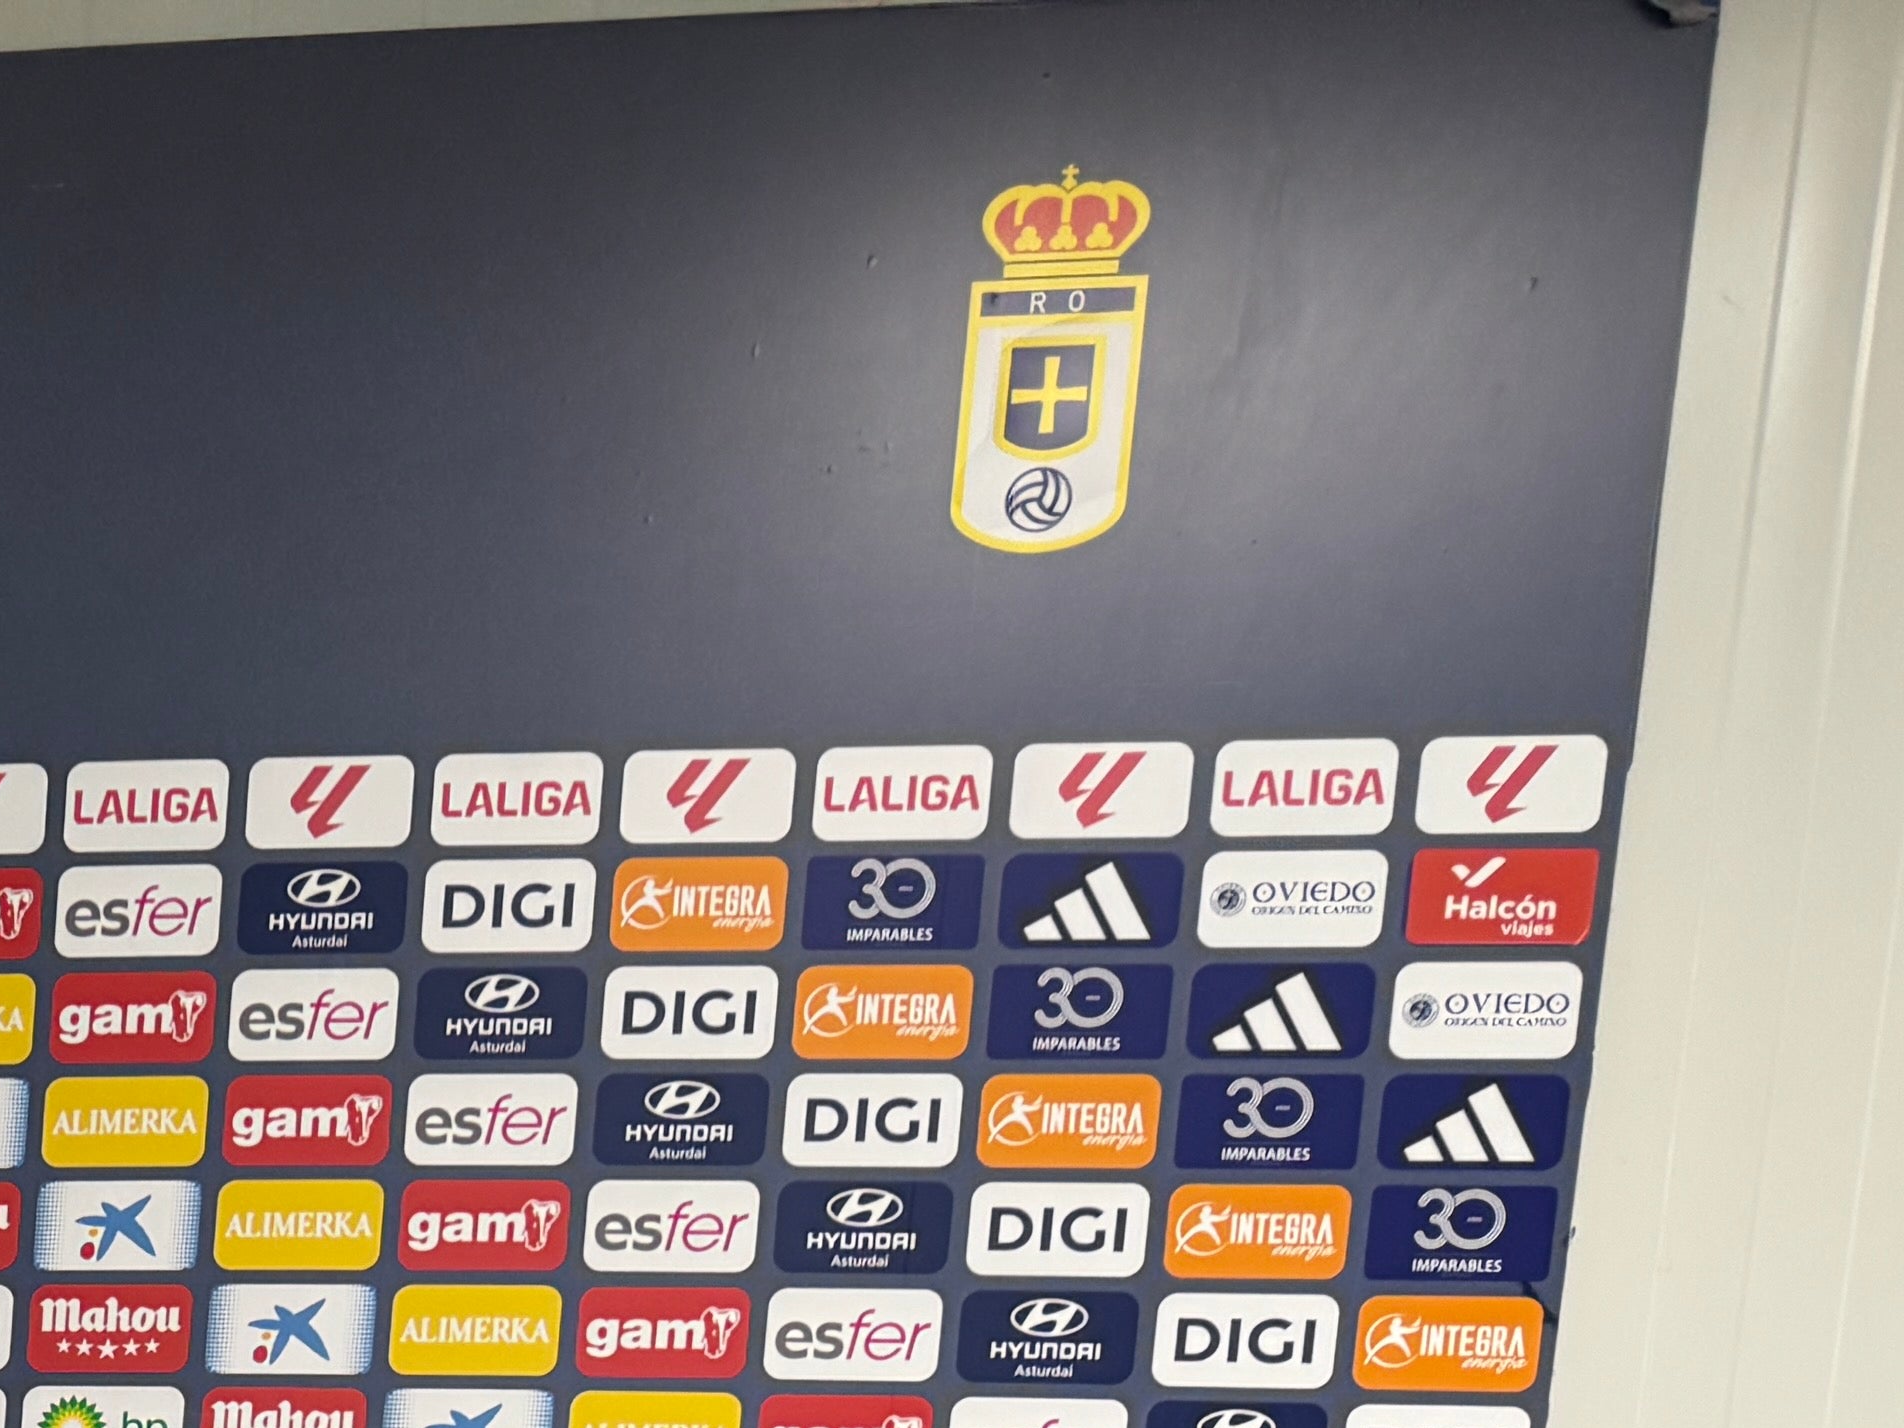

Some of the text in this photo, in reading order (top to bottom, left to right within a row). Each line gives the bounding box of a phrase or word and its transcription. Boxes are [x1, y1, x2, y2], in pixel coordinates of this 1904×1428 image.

[440, 781, 592, 818] LALIGA
[1221, 769, 1385, 807] LALIGA
[443, 884, 574, 928] DIGI
[848, 858, 936, 920] 30
[1445, 895, 1556, 920] Halcón
[65, 885, 212, 937] esfer
[268, 912, 374, 931] HYUNDAI
[1501, 920, 1553, 938] viajes
[846, 927, 934, 942] IMPARABLES
[856, 992, 956, 1025] INTEGRA
[1445, 993, 1570, 1014] OVIEDO
[776, 1309, 931, 1360] esfer
[1175, 1319, 1316, 1363] DIGI
